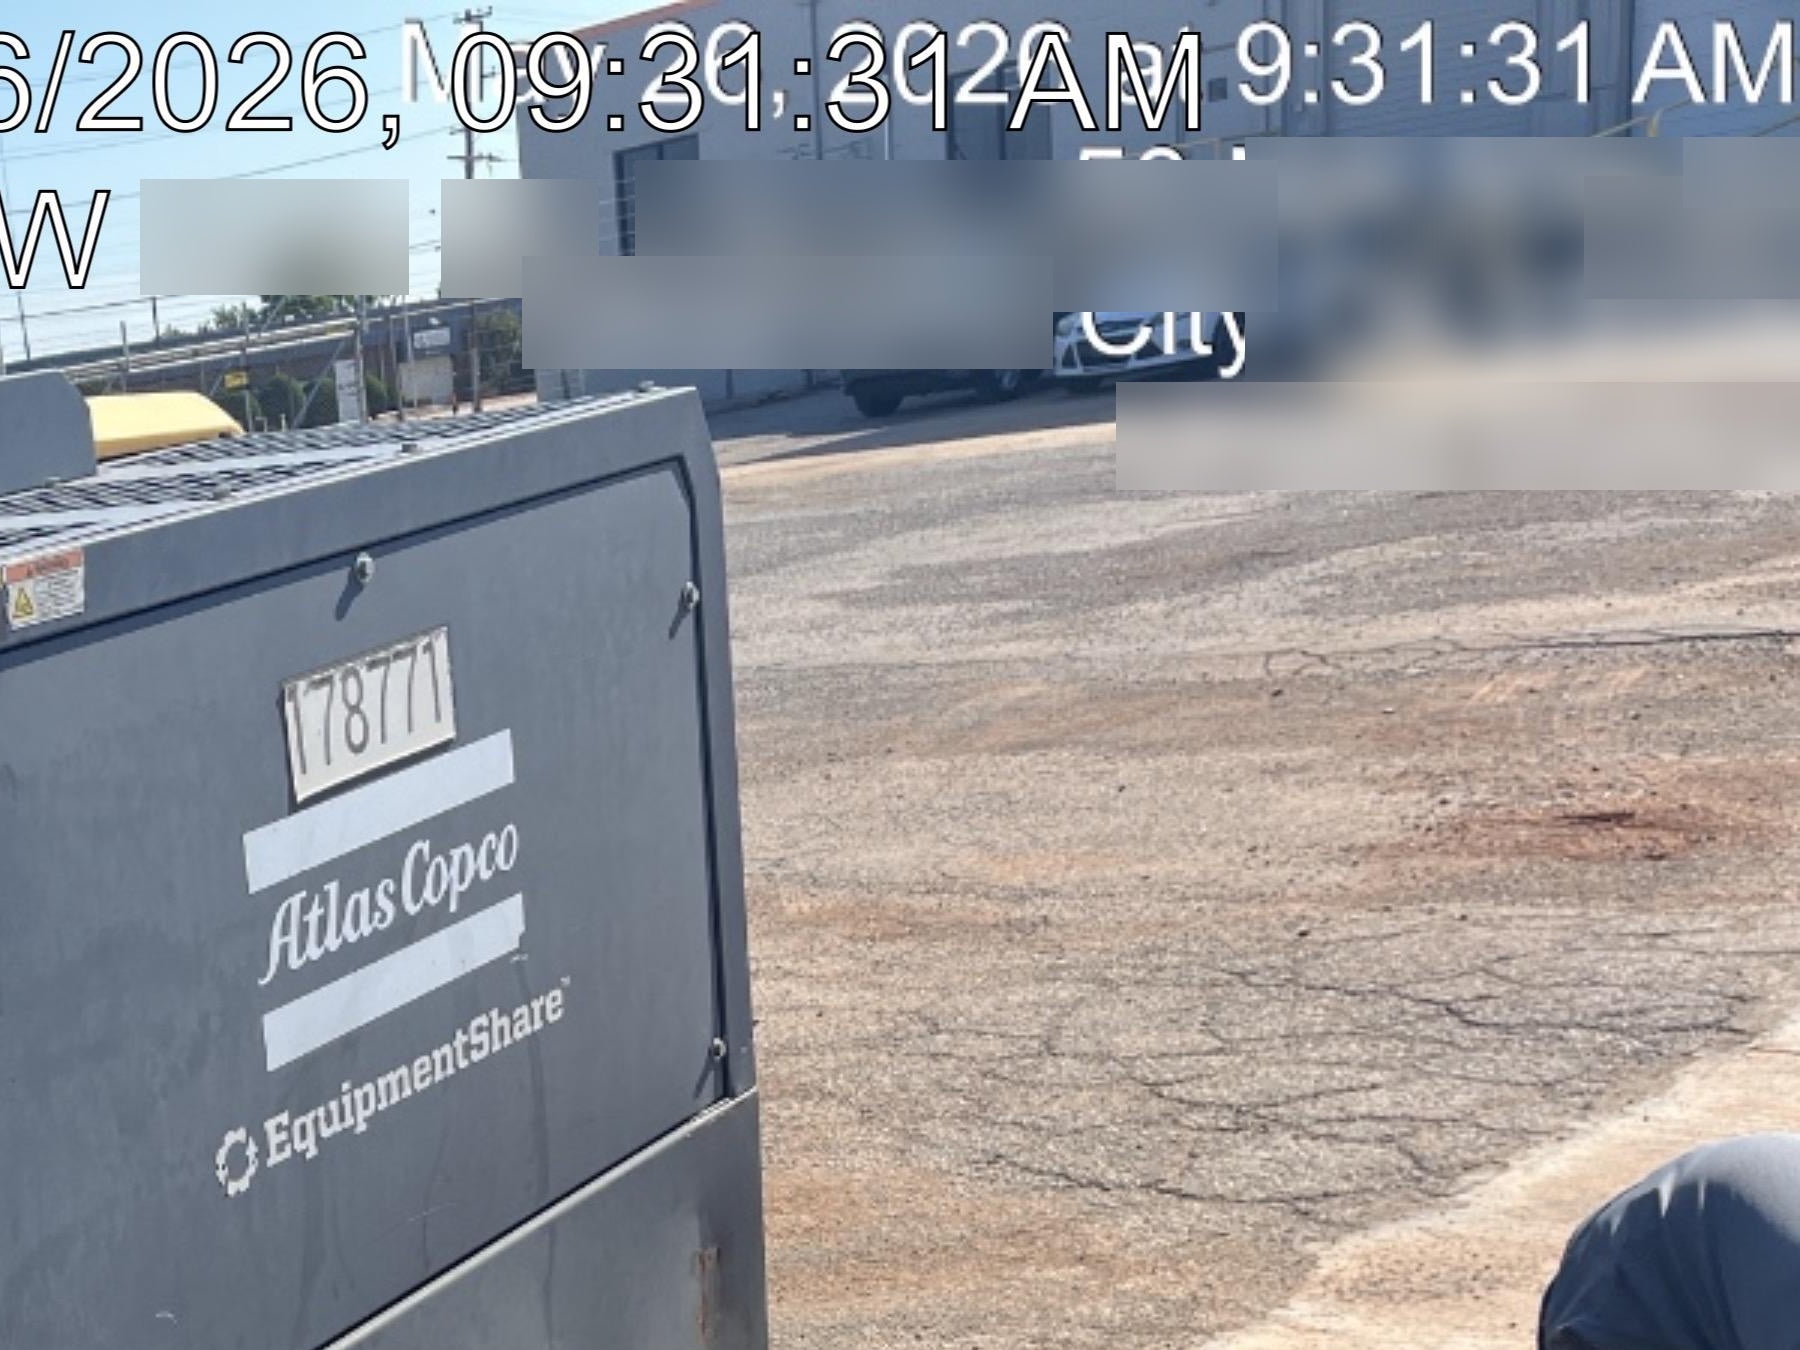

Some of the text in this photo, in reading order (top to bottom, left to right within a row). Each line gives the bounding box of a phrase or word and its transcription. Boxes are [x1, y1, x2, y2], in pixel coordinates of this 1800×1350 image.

[287, 636, 443, 776] 178771
[258, 823, 520, 986] Atlas Copco
[263, 988, 564, 1170] EquipmentShare
